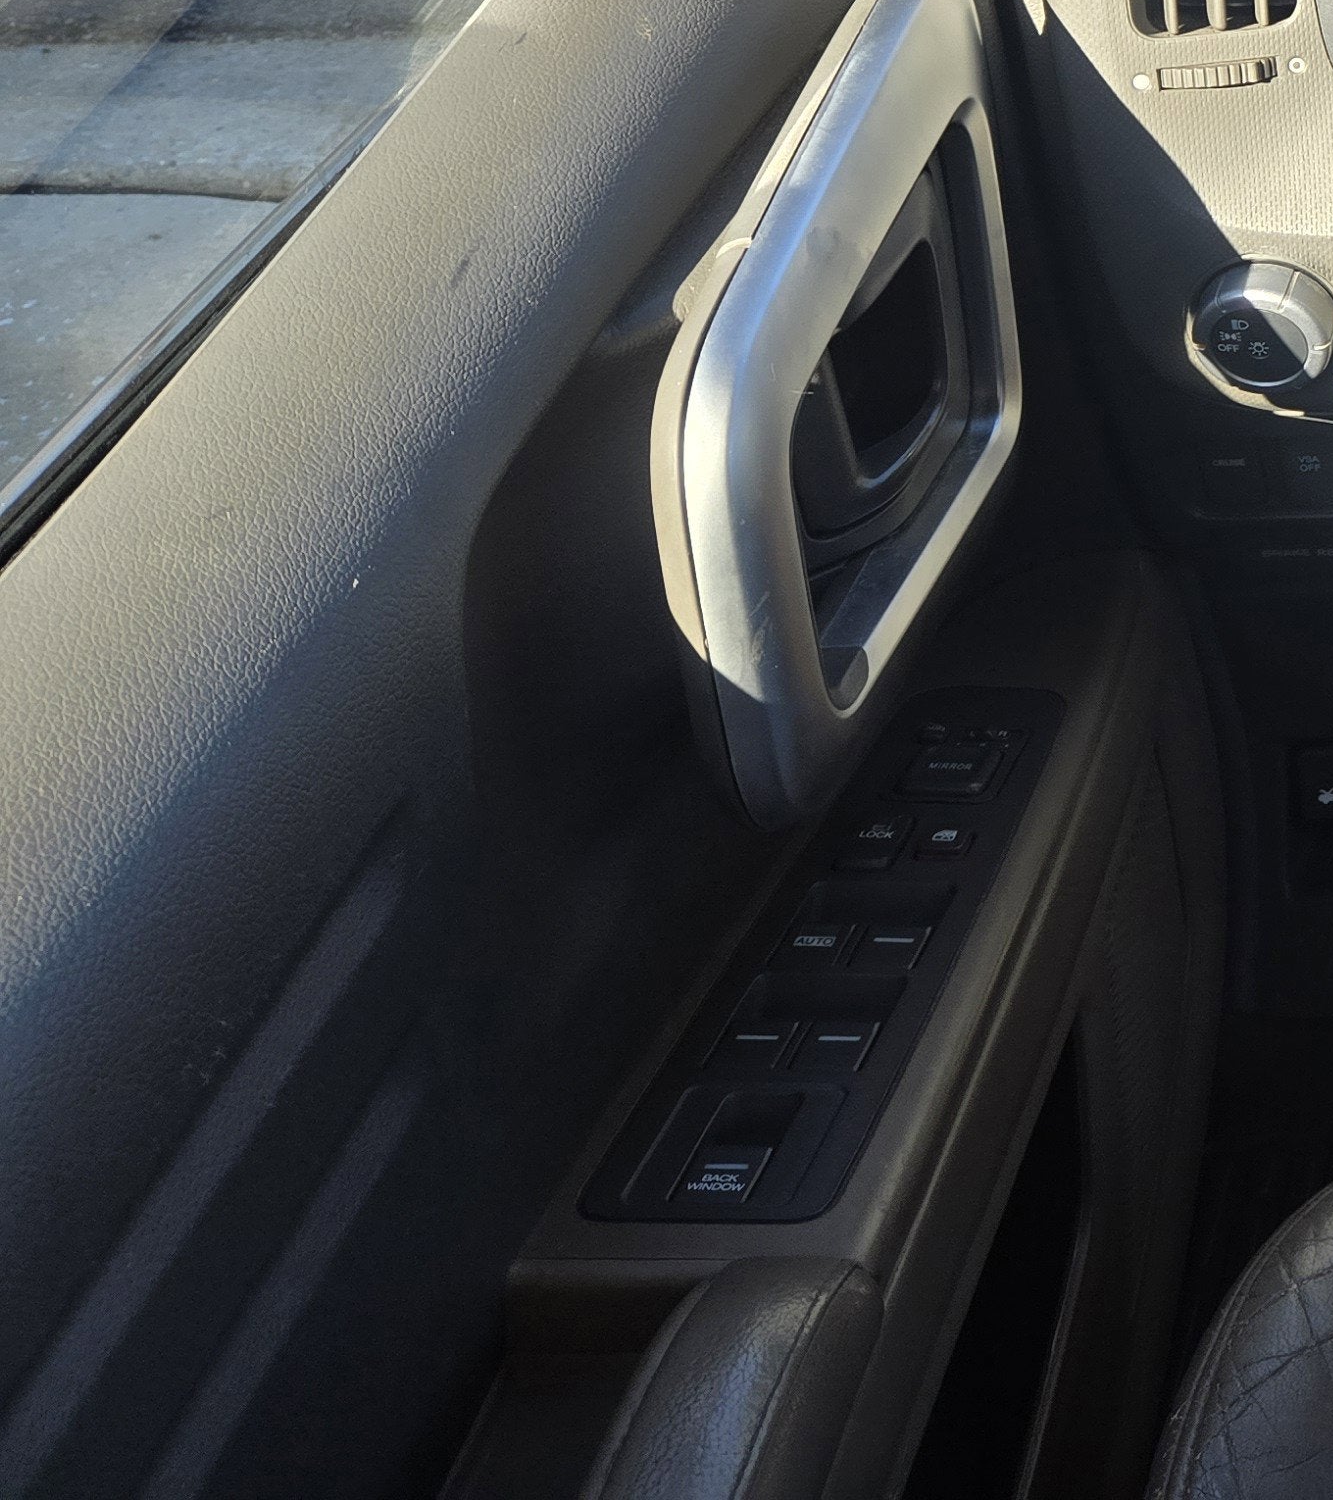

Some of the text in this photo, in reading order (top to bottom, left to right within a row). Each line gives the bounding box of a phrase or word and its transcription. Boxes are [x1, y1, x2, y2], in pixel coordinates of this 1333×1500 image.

[1217, 344, 1240, 352] OFF
[1300, 464, 1320, 472] OFF
[928, 762, 973, 771] MIRROR
[859, 830, 895, 839] LOCK
[794, 936, 836, 947] AUTO
[702, 1173, 740, 1182] BACK
[687, 1182, 745, 1192] WINDOW
